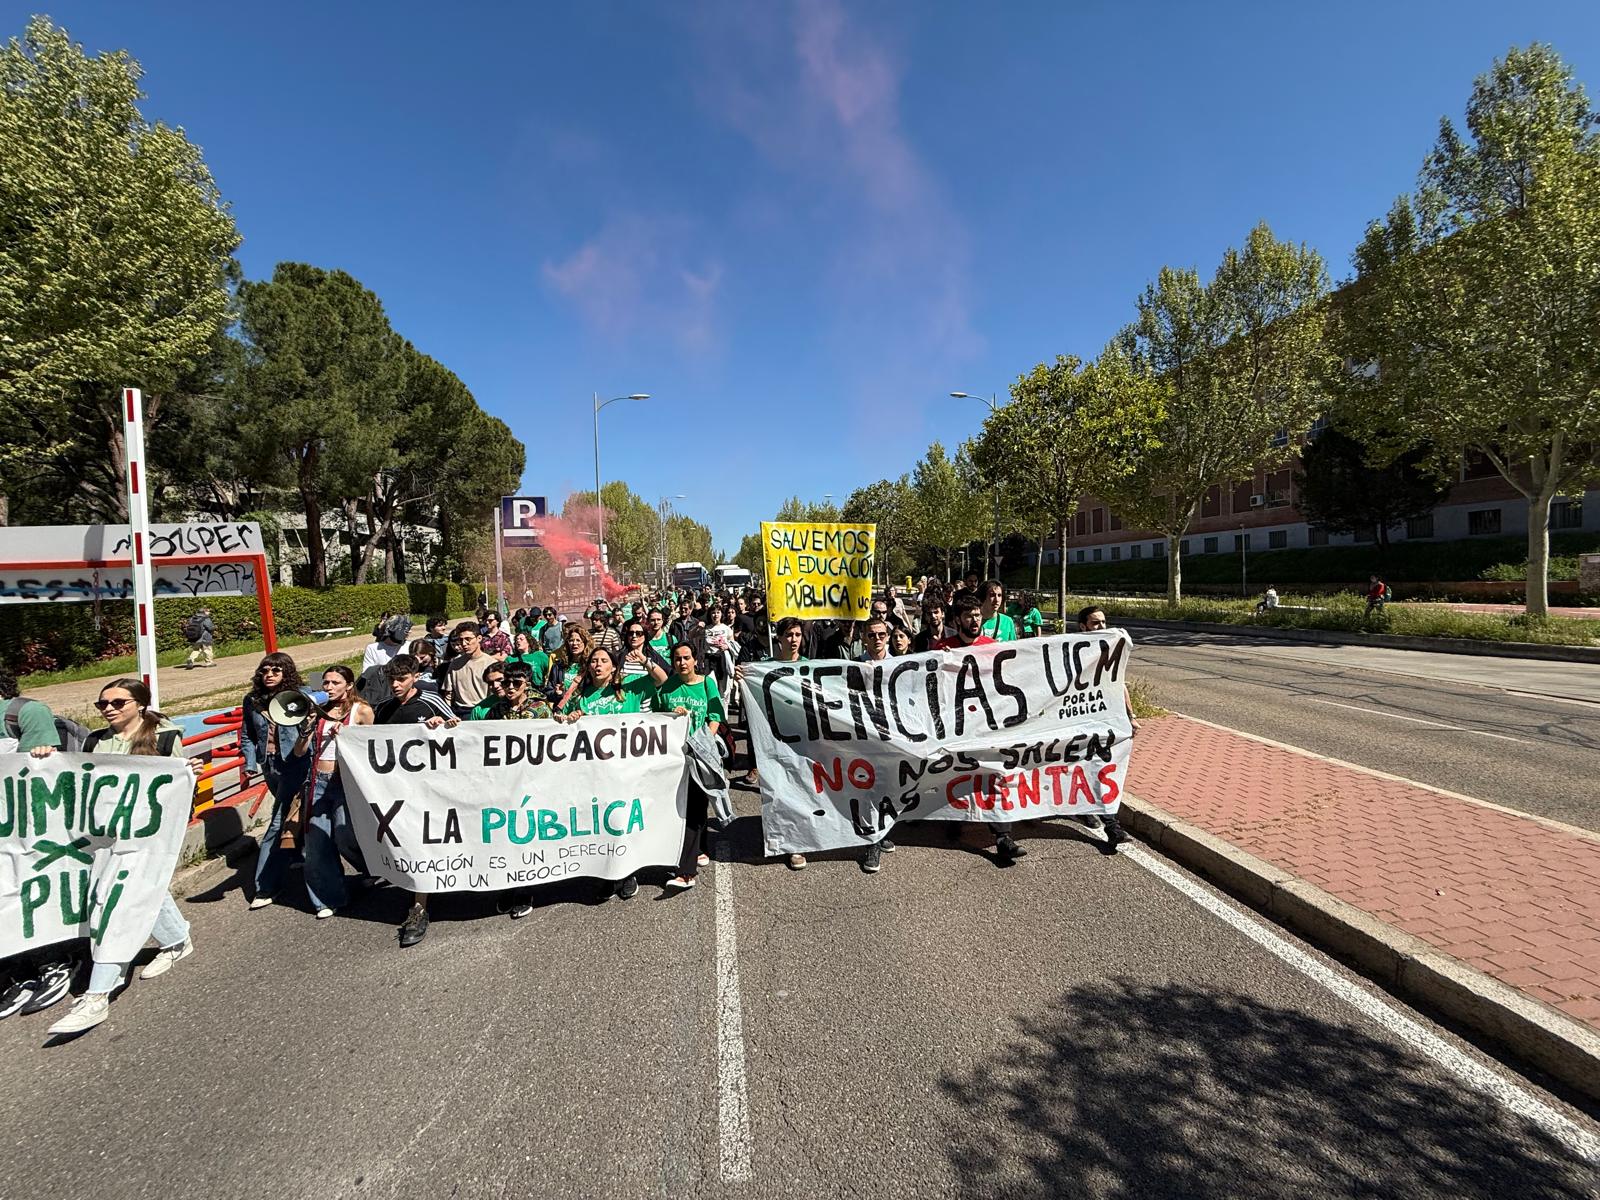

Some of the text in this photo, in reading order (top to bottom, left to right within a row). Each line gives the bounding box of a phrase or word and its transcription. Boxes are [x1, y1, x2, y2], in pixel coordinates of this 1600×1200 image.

[512, 500, 537, 527] P
[771, 529, 870, 554] SALVEMOS
[777, 555, 792, 575] LA
[785, 578, 851, 611] PÚBLICA
[762, 637, 1126, 743] CIENCIAS UCM
[1063, 689, 1104, 706] POR LA
[1058, 701, 1107, 719] PÚBLICA
[367, 720, 668, 774] UCM EDUCACIÓN
[812, 757, 876, 793] NO
[899, 751, 980, 787] NOS
[849, 763, 1119, 836] LAS CUENTAS
[369, 794, 645, 847] X LA PÚBLICA
[381, 842, 627, 874] LA EDUCACIÓN ES UN DERECHO
[435, 861, 581, 890] NO UN NEGOCIO
